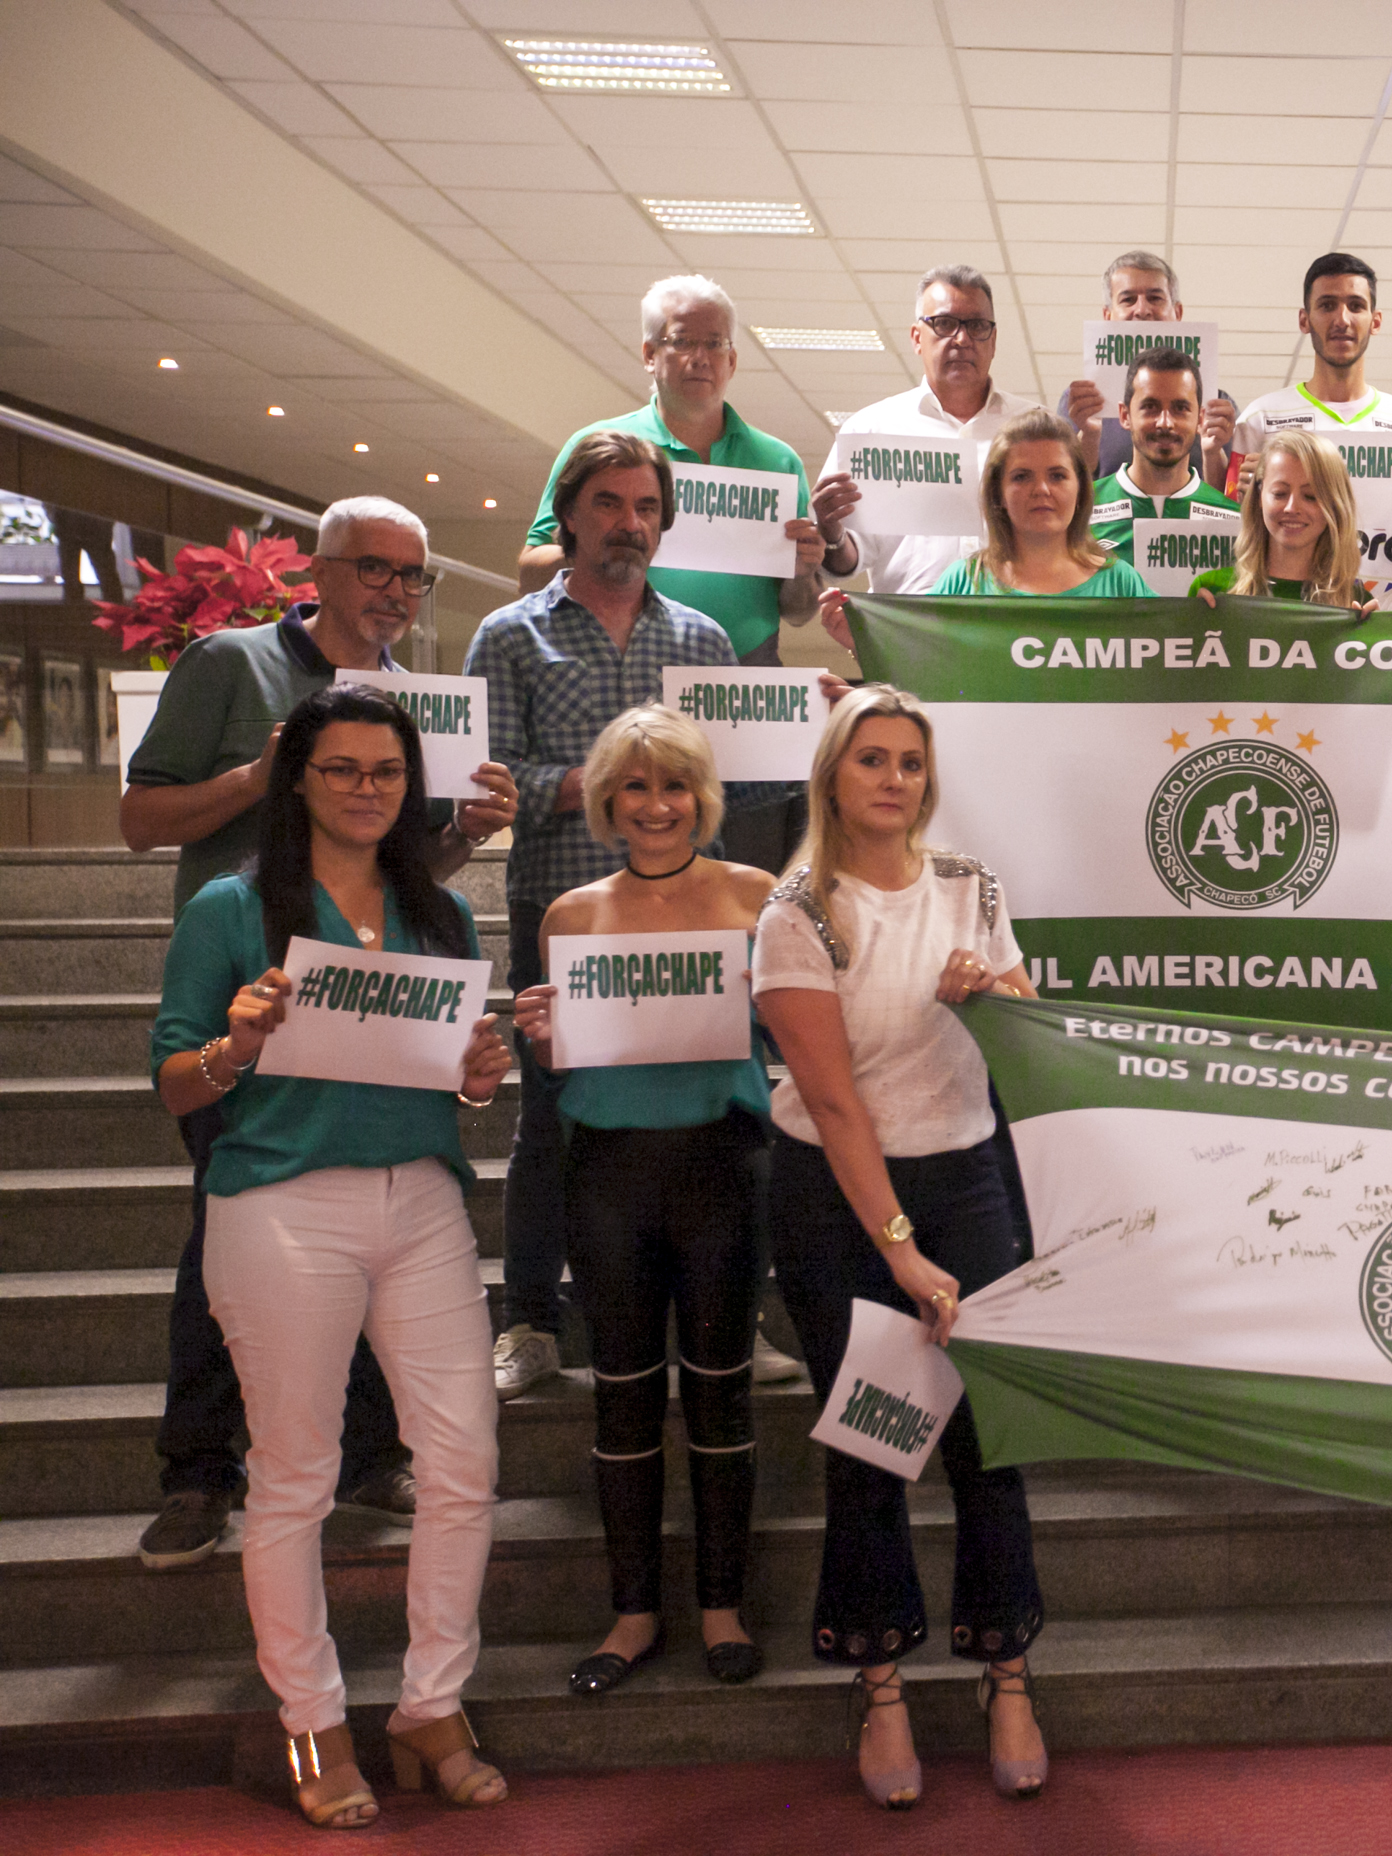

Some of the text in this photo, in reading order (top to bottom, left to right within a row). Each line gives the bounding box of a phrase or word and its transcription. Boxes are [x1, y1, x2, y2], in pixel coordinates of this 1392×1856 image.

[850, 447, 962, 488] #FORÇACHAPE
[674, 478, 779, 523] FORÇACHAPE
[1010, 629, 1231, 669] CAMPEÃ
[1248, 638, 1318, 669] DA
[679, 683, 809, 729] #FORÇACHAPE
[1155, 749, 1330, 887] ASSOCIAÇÃO CHAPECOENSE DE FUTEBOL
[1265, 886, 1282, 900] SC
[569, 951, 724, 1006] #FORÇACHAPE
[1088, 956, 1378, 990] AMERICANA
[296, 965, 466, 1023] #FORÇACHAPE
[1064, 1017, 1232, 1048] Eternos
[1118, 1055, 1189, 1081] nos
[1205, 1061, 1349, 1095] nossos
